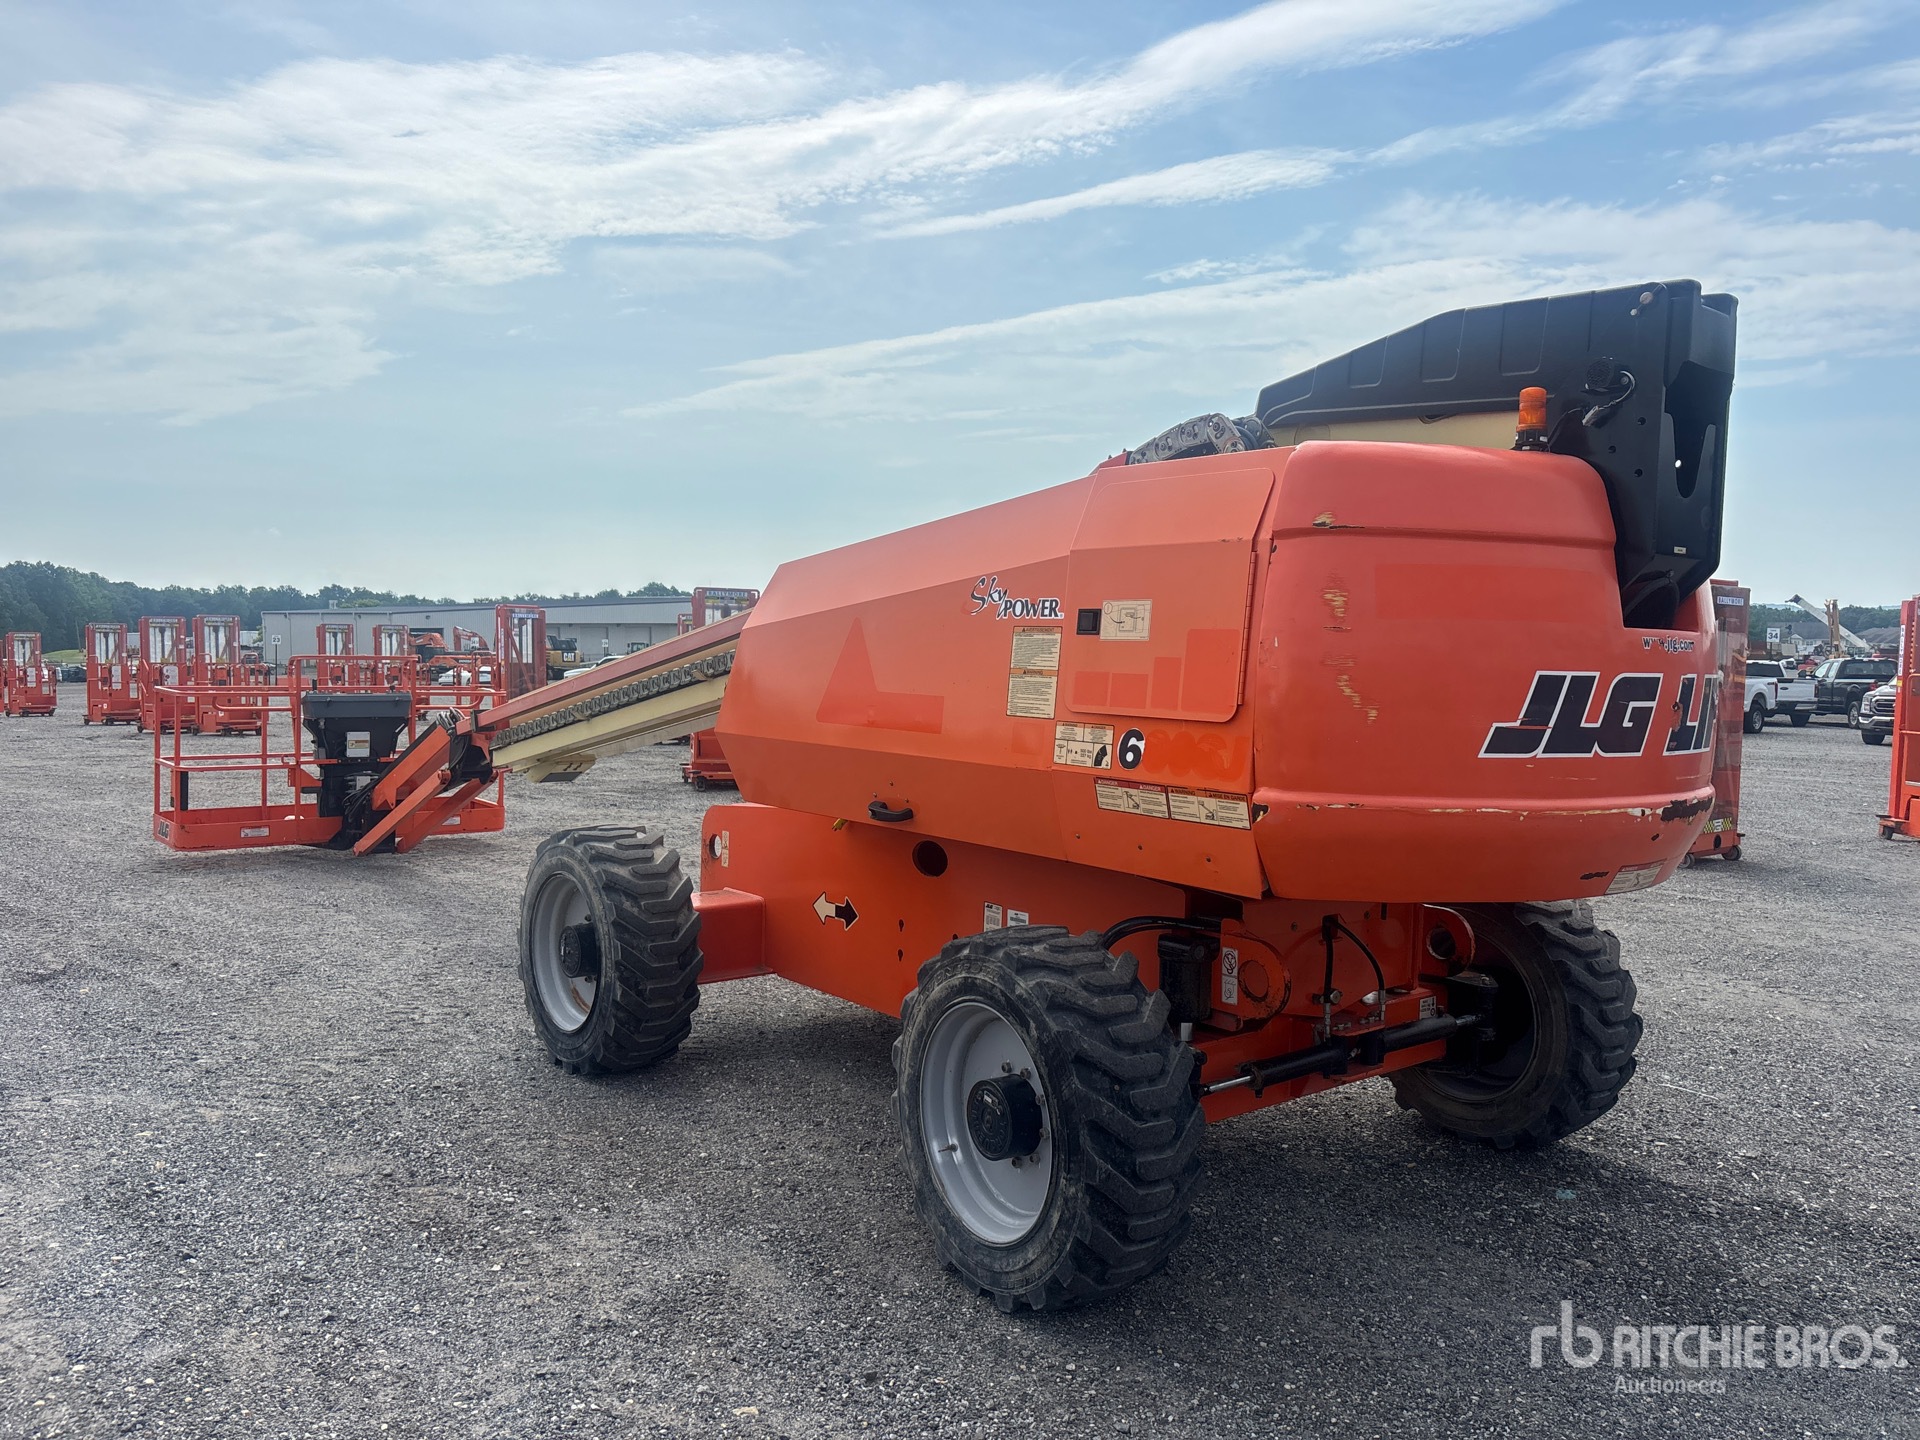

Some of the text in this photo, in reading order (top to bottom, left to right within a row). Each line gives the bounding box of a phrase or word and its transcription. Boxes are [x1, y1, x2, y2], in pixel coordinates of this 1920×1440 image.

[971, 576, 1060, 619] Sky POWER
[563, 652, 575, 662] CAT
[1642, 635, 1695, 653] w.jlg.com
[1478, 671, 1663, 758] JLG
[1662, 674, 1718, 757] LI
[1118, 728, 1145, 770] 6
[158, 820, 170, 839] JLG
